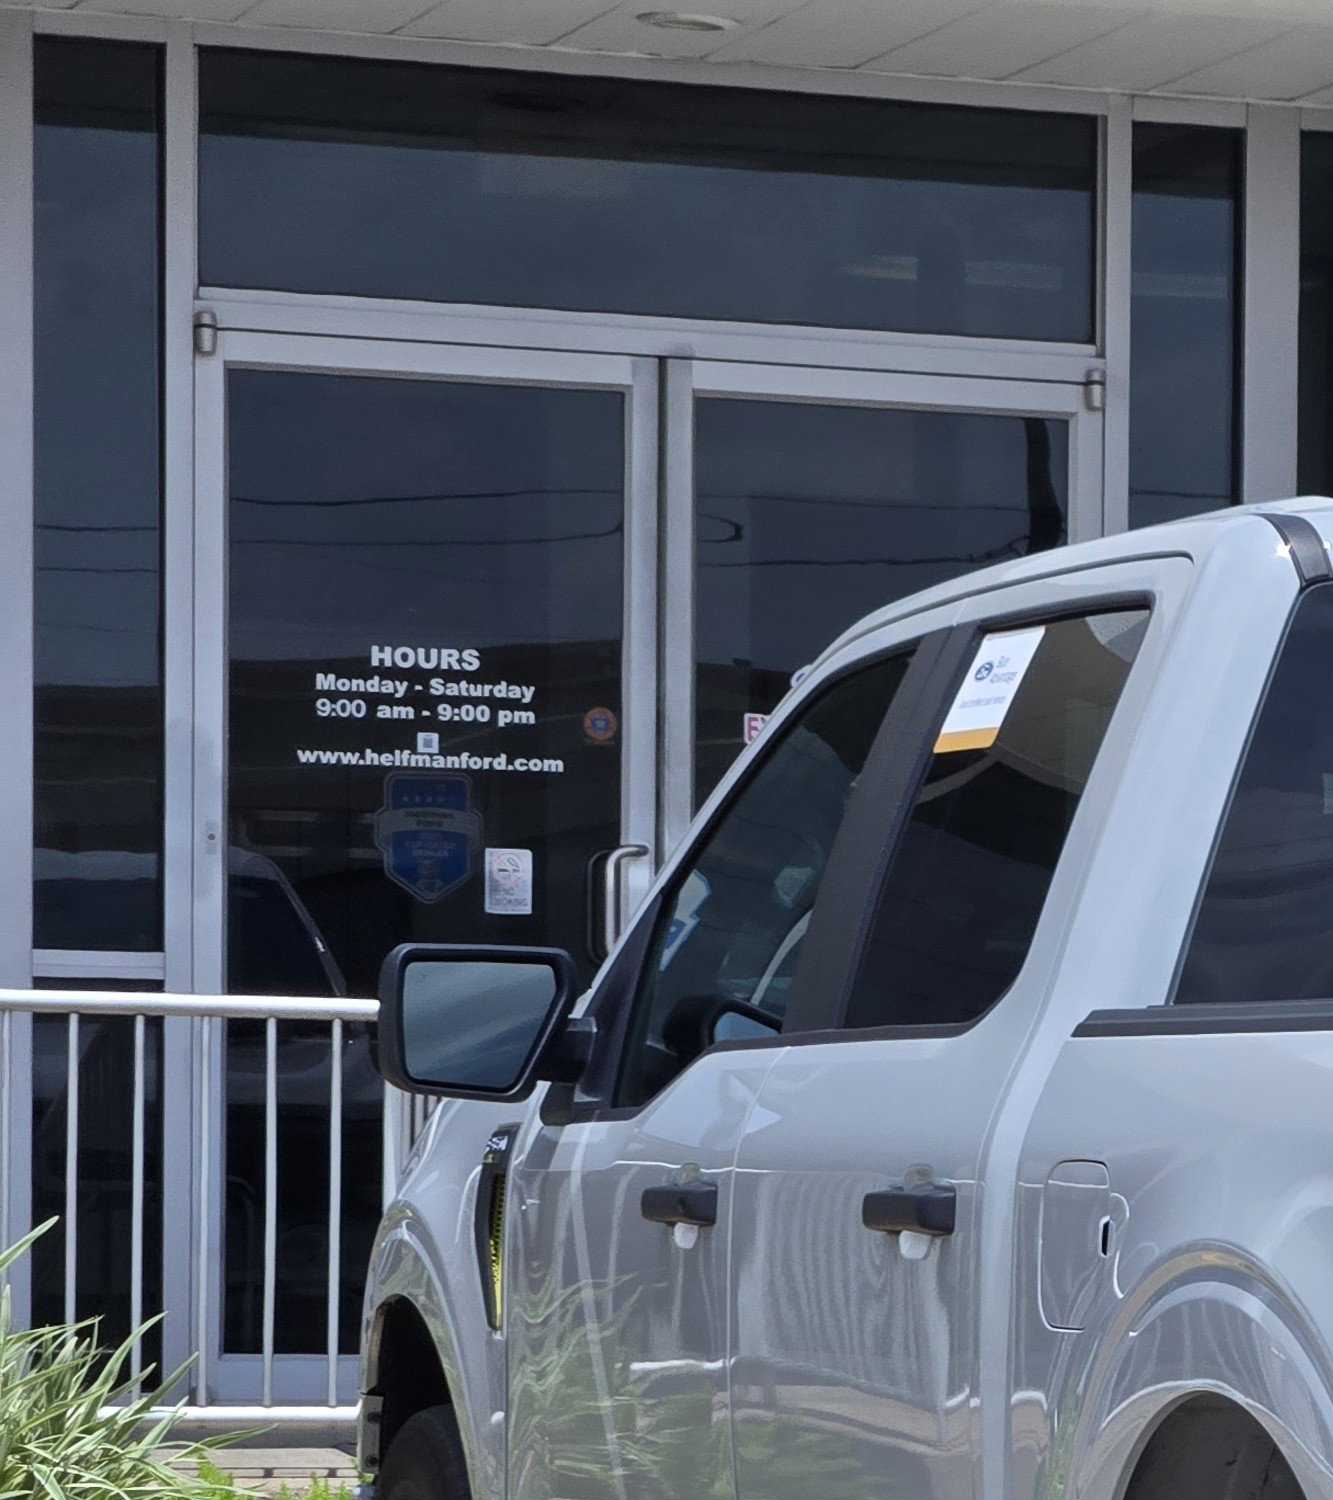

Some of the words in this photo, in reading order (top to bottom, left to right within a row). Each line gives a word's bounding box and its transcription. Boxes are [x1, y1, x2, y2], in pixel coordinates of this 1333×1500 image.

[371, 645, 480, 671] HOURS
[315, 672, 409, 698] Monday
[429, 677, 536, 703] Saturday
[315, 698, 367, 718] 9:00
[376, 704, 415, 719] am
[437, 703, 491, 722] 9:00
[498, 709, 536, 727] pm
[296, 748, 564, 772] www.helfmanford.com
